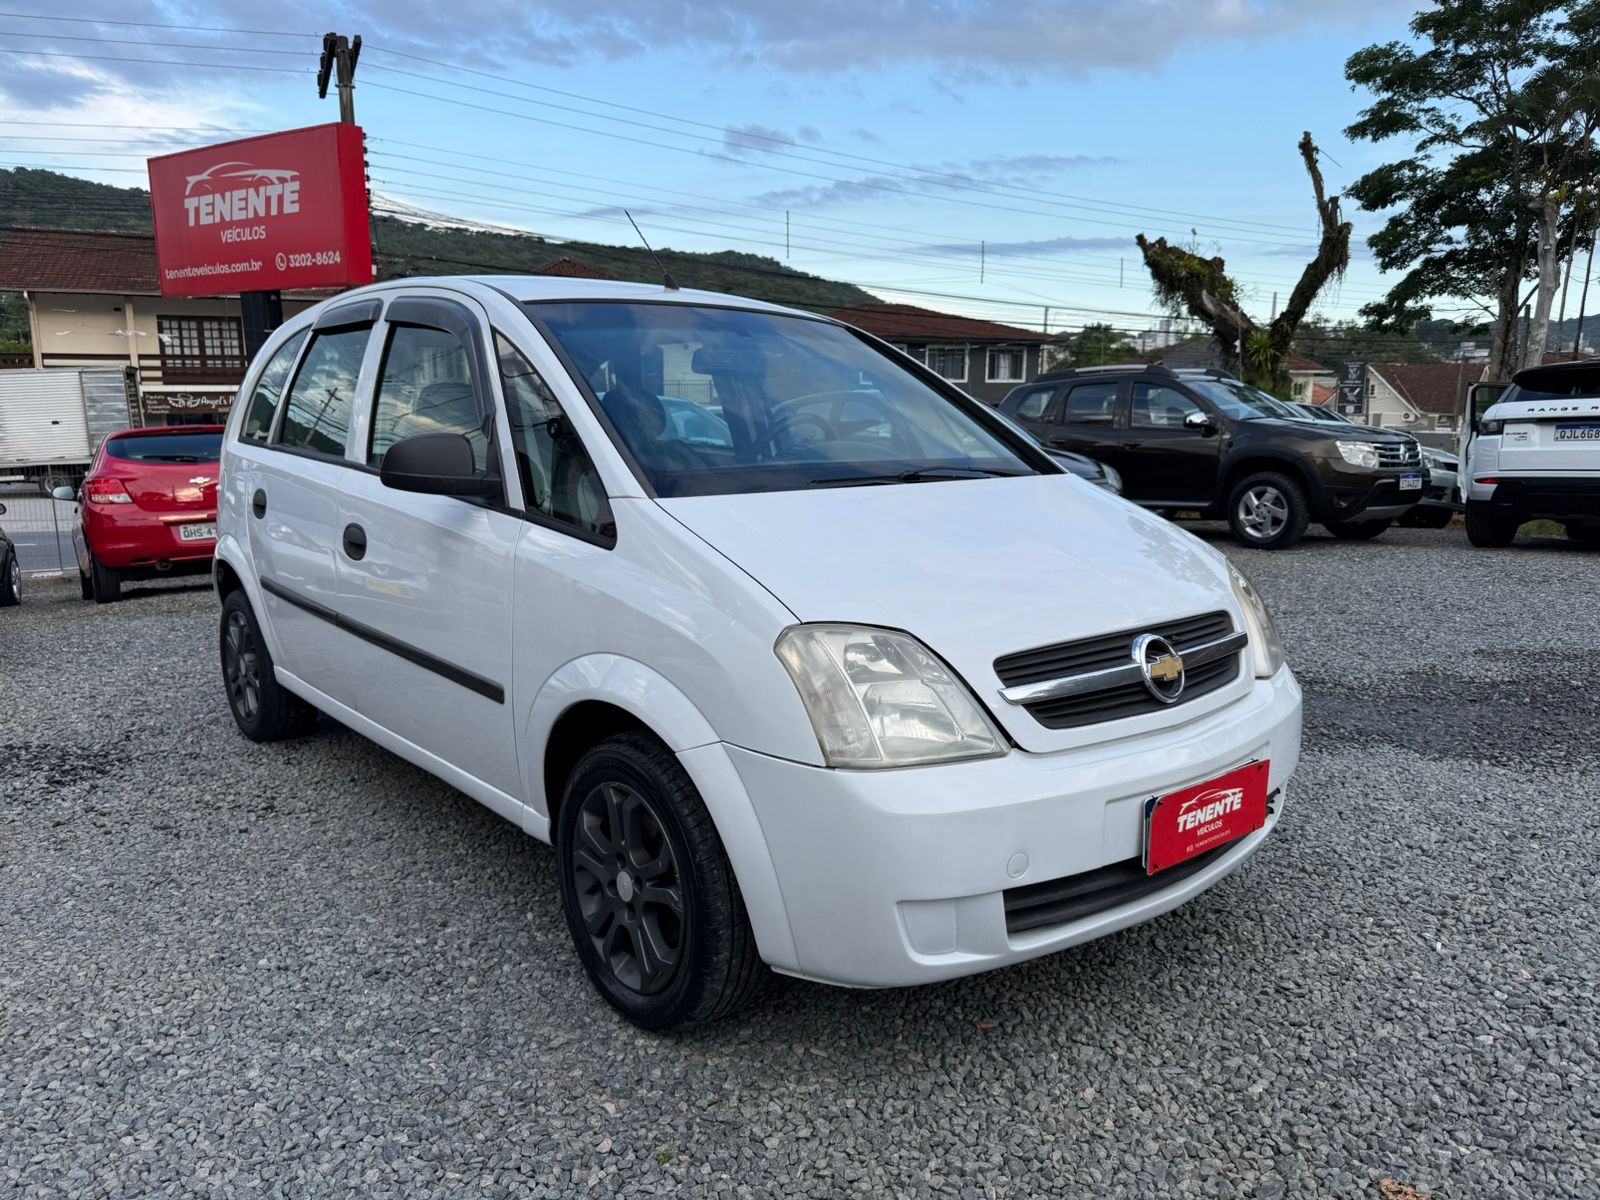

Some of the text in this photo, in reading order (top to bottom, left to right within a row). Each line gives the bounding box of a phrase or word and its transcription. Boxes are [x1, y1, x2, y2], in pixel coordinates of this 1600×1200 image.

[184, 181, 300, 227] TENENTE
[221, 225, 266, 243] VEÍCULOS
[165, 258, 263, 280] tenenteveiculos.com.br
[288, 250, 341, 268] 3202-8624
[1177, 792, 1243, 833] TENENTE
